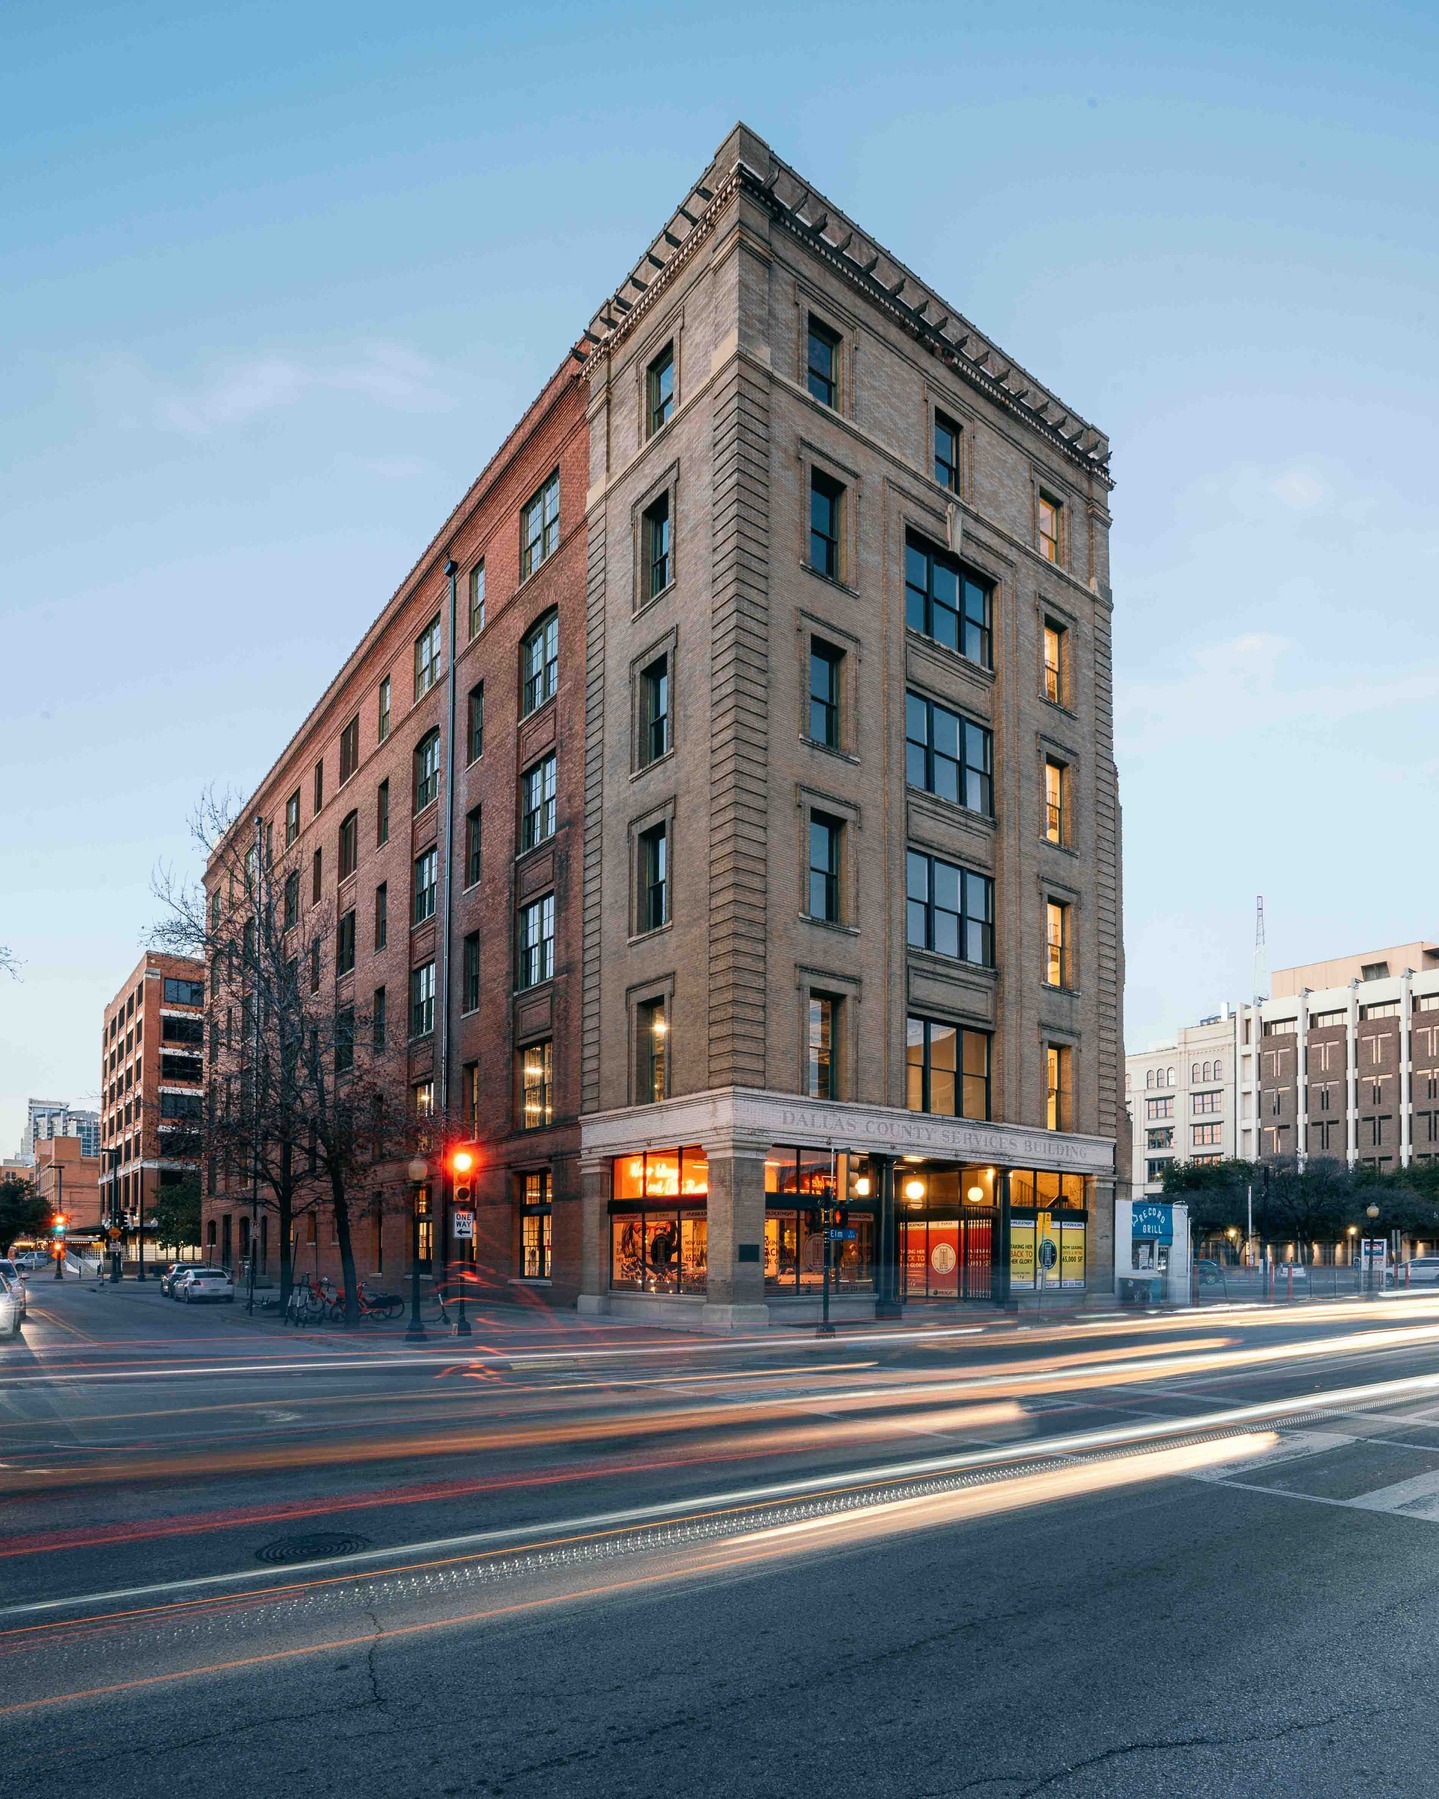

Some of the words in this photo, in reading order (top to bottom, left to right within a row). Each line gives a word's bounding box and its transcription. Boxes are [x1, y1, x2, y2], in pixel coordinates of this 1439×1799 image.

[782, 1110, 856, 1131] DALLAS
[865, 1120, 935, 1140] COUNTY
[942, 1130, 1017, 1150] SERVICES
[1024, 1140, 1087, 1158] BUILDING
[1139, 1208, 1165, 1224] RECORD
[830, 1229, 843, 1238] Elm
[1142, 1224, 1162, 1234] GRILL
[1026, 1250, 1033, 1258] TO
